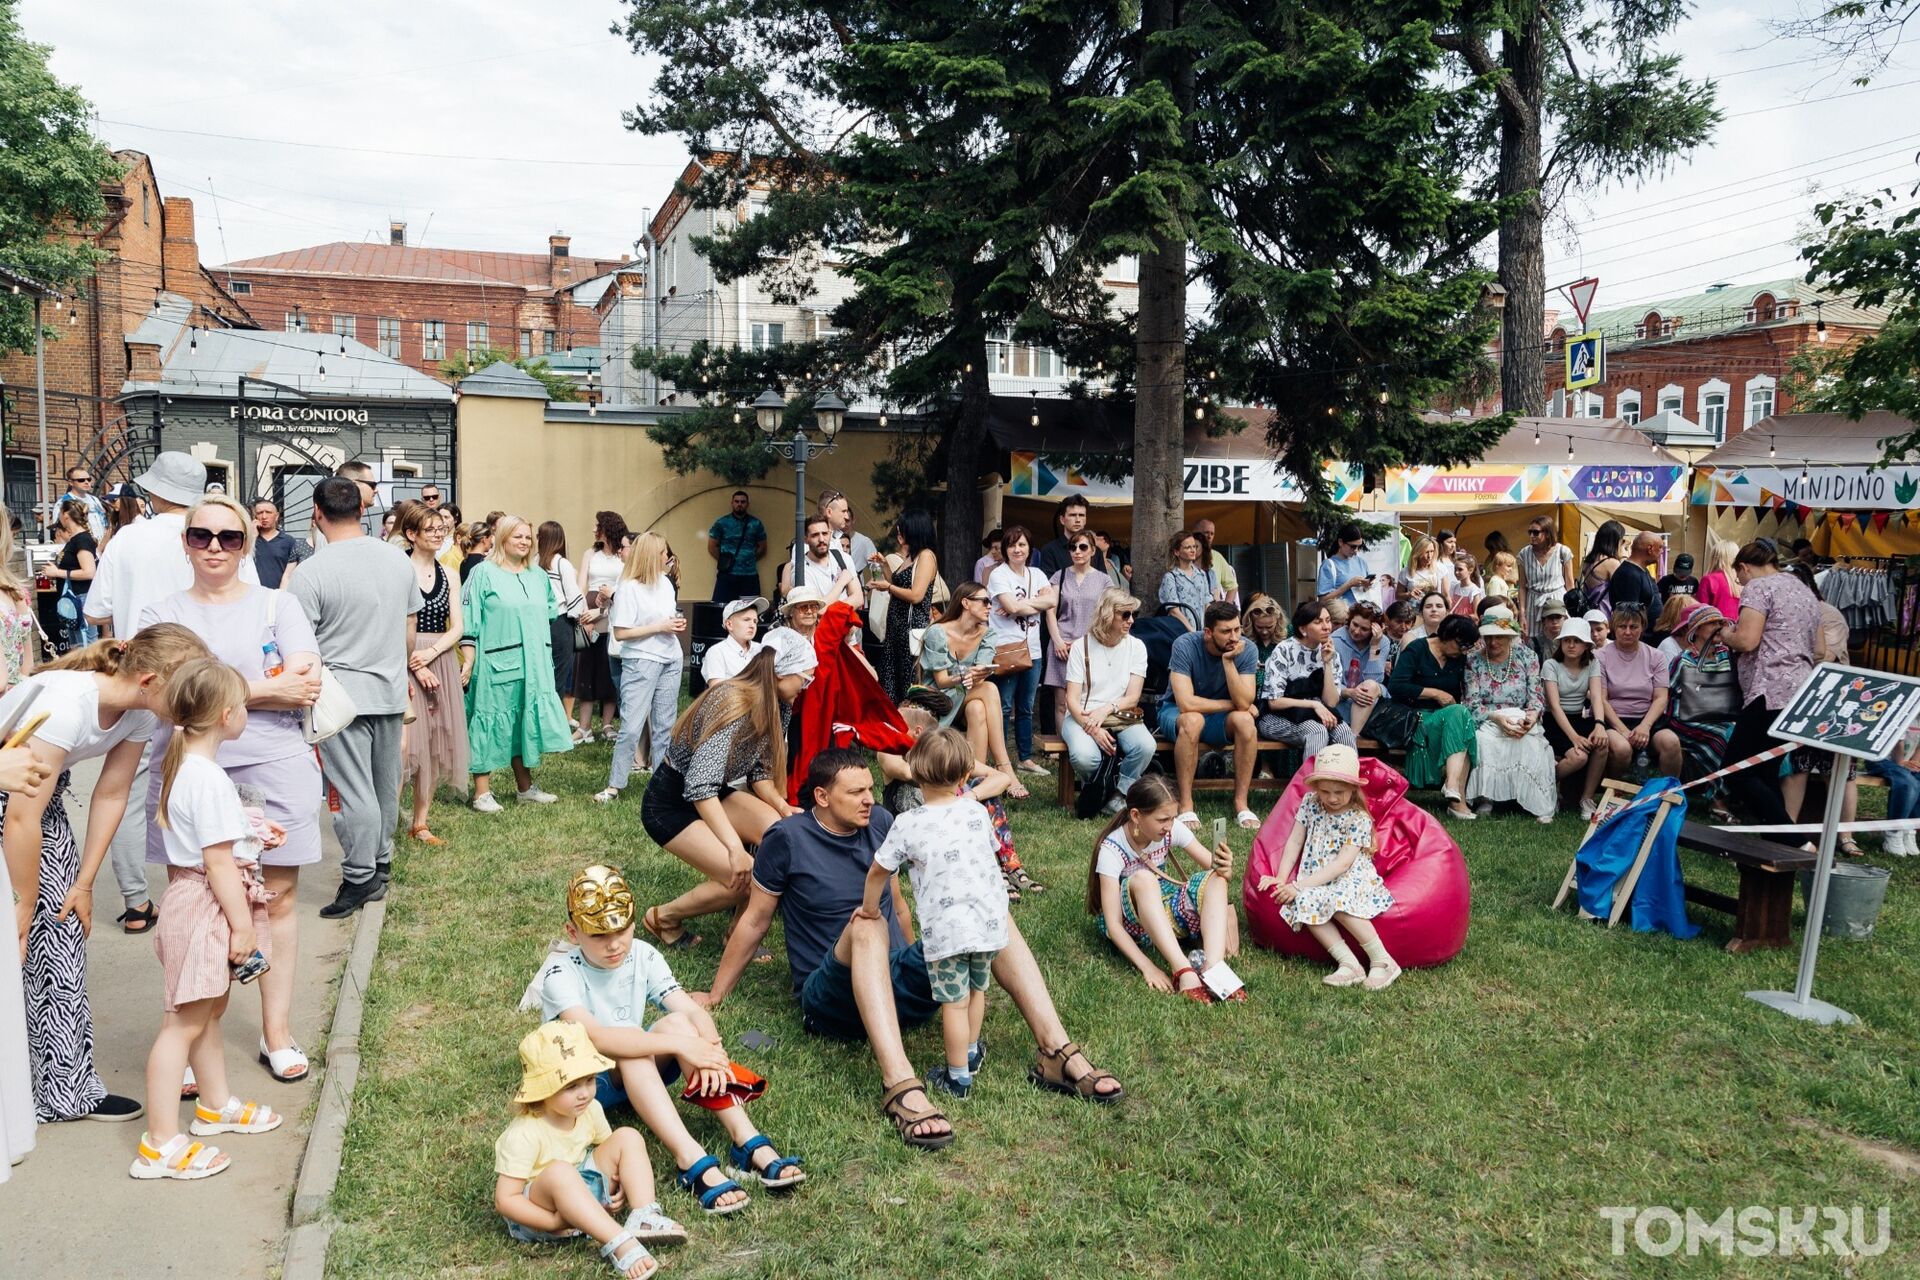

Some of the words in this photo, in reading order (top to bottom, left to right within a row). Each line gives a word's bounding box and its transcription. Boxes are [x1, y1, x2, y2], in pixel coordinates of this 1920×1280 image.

[1591, 470, 1654, 484] ЦАРСТВО
[1442, 478, 1486, 491] VIKKY
[1586, 485, 1659, 498] КАРОЛИНЫ
